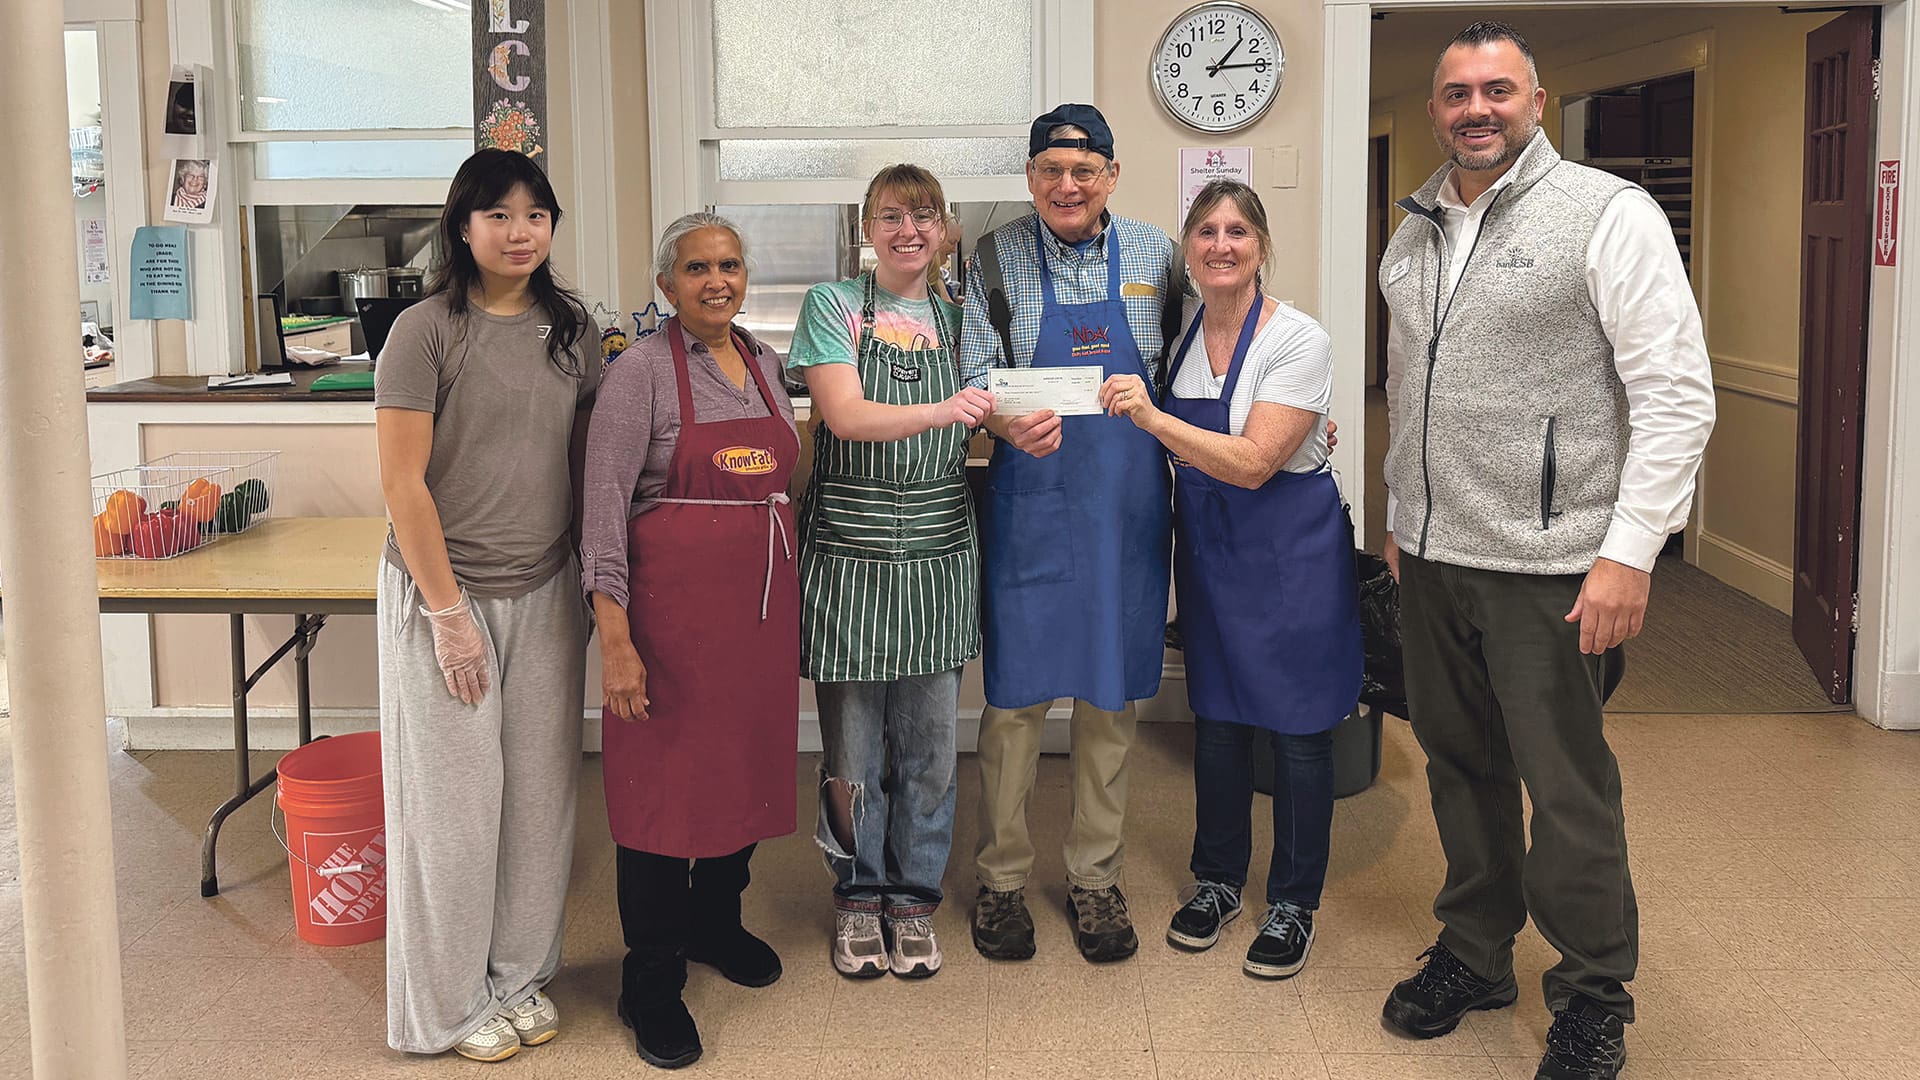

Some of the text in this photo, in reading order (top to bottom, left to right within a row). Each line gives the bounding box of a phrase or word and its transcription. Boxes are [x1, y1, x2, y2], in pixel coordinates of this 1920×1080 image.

[1190, 26, 1204, 42] 11
[1208, 19, 1225, 34] 12
[1236, 24, 1243, 39] 1
[1175, 43, 1192, 58] 10
[1249, 38, 1260, 53] 2
[1169, 63, 1181, 78] 9
[1254, 58, 1266, 73] 3
[1177, 83, 1189, 98] 8
[1248, 79, 1260, 94] 4
[1192, 96, 1203, 111] 7
[1213, 101, 1225, 116] 6
[1234, 94, 1245, 109] 5
[1216, 167, 1242, 175] Sunday
[1881, 170, 1896, 184] FIRE
[317, 843, 357, 880] THE
